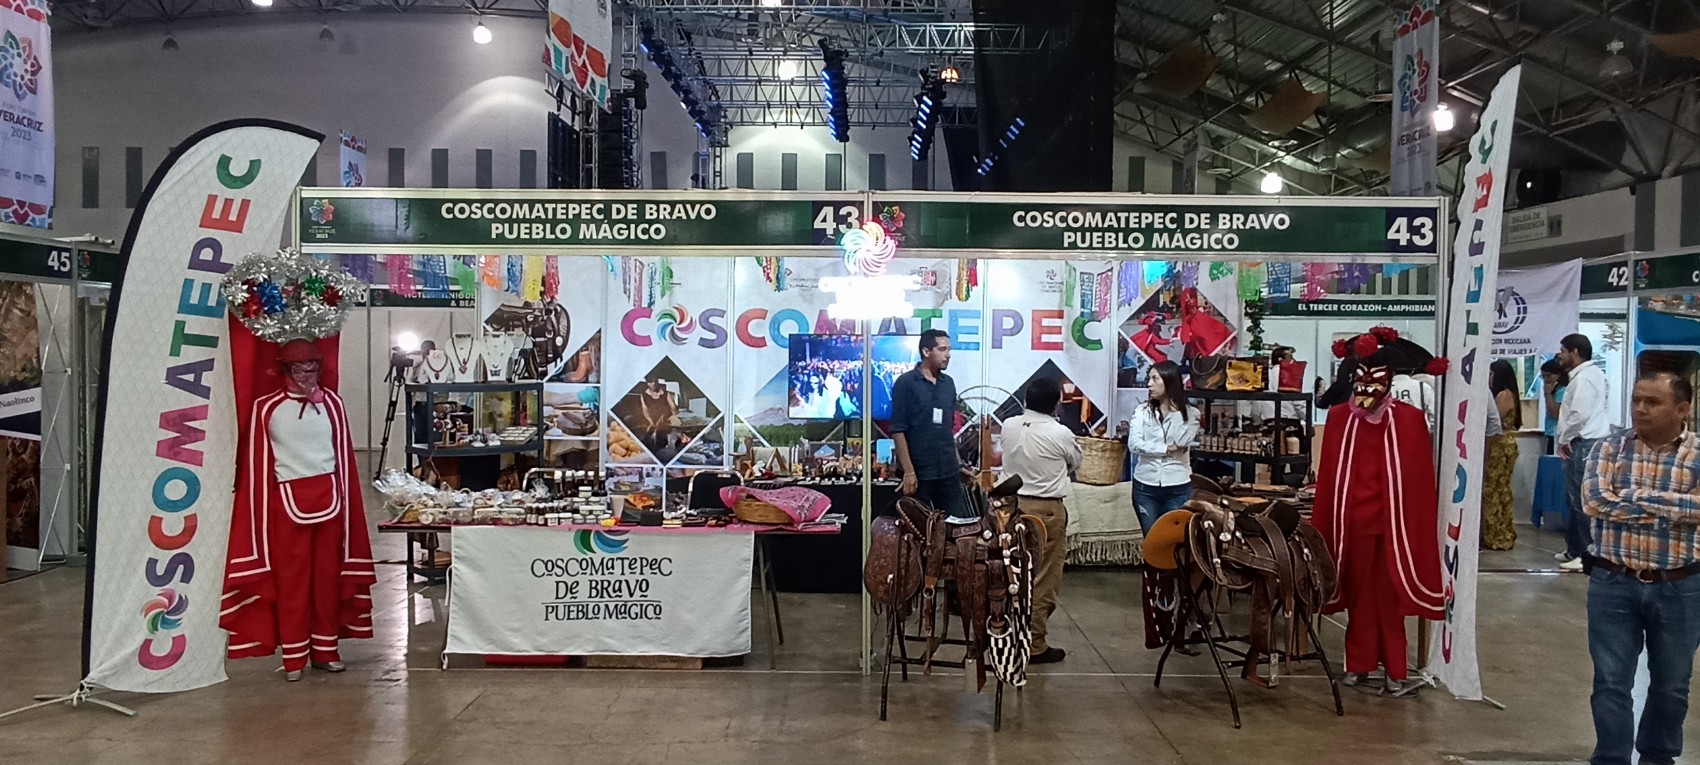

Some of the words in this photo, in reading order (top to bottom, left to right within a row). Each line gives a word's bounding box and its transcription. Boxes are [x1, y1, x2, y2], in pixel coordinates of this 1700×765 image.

[0, 108, 44, 133] VERACRUZ
[11, 126, 32, 141] 2023
[441, 203, 605, 219] COSCOMATEPEC
[611, 203, 638, 219] DE
[645, 203, 717, 220] BRAVO
[813, 205, 861, 234] 43
[1012, 210, 1178, 229] COSCOMATEPEC
[1184, 213, 1211, 229] DE
[1218, 213, 1291, 231] BRAVO
[491, 222, 572, 239] PUEBLO
[578, 219, 667, 240] MÁGICO
[1063, 231, 1145, 249] PUEBLO
[1151, 229, 1240, 249] MÁGICO
[1387, 216, 1434, 246] 43
[47, 250, 71, 272] 45
[1608, 266, 1628, 287] 42
[1298, 303, 1307, 311] EL
[1309, 303, 1338, 312] TERCER
[620, 304, 1104, 351] COSCOMTEPEC
[0, 396, 35, 408] Naolinco
